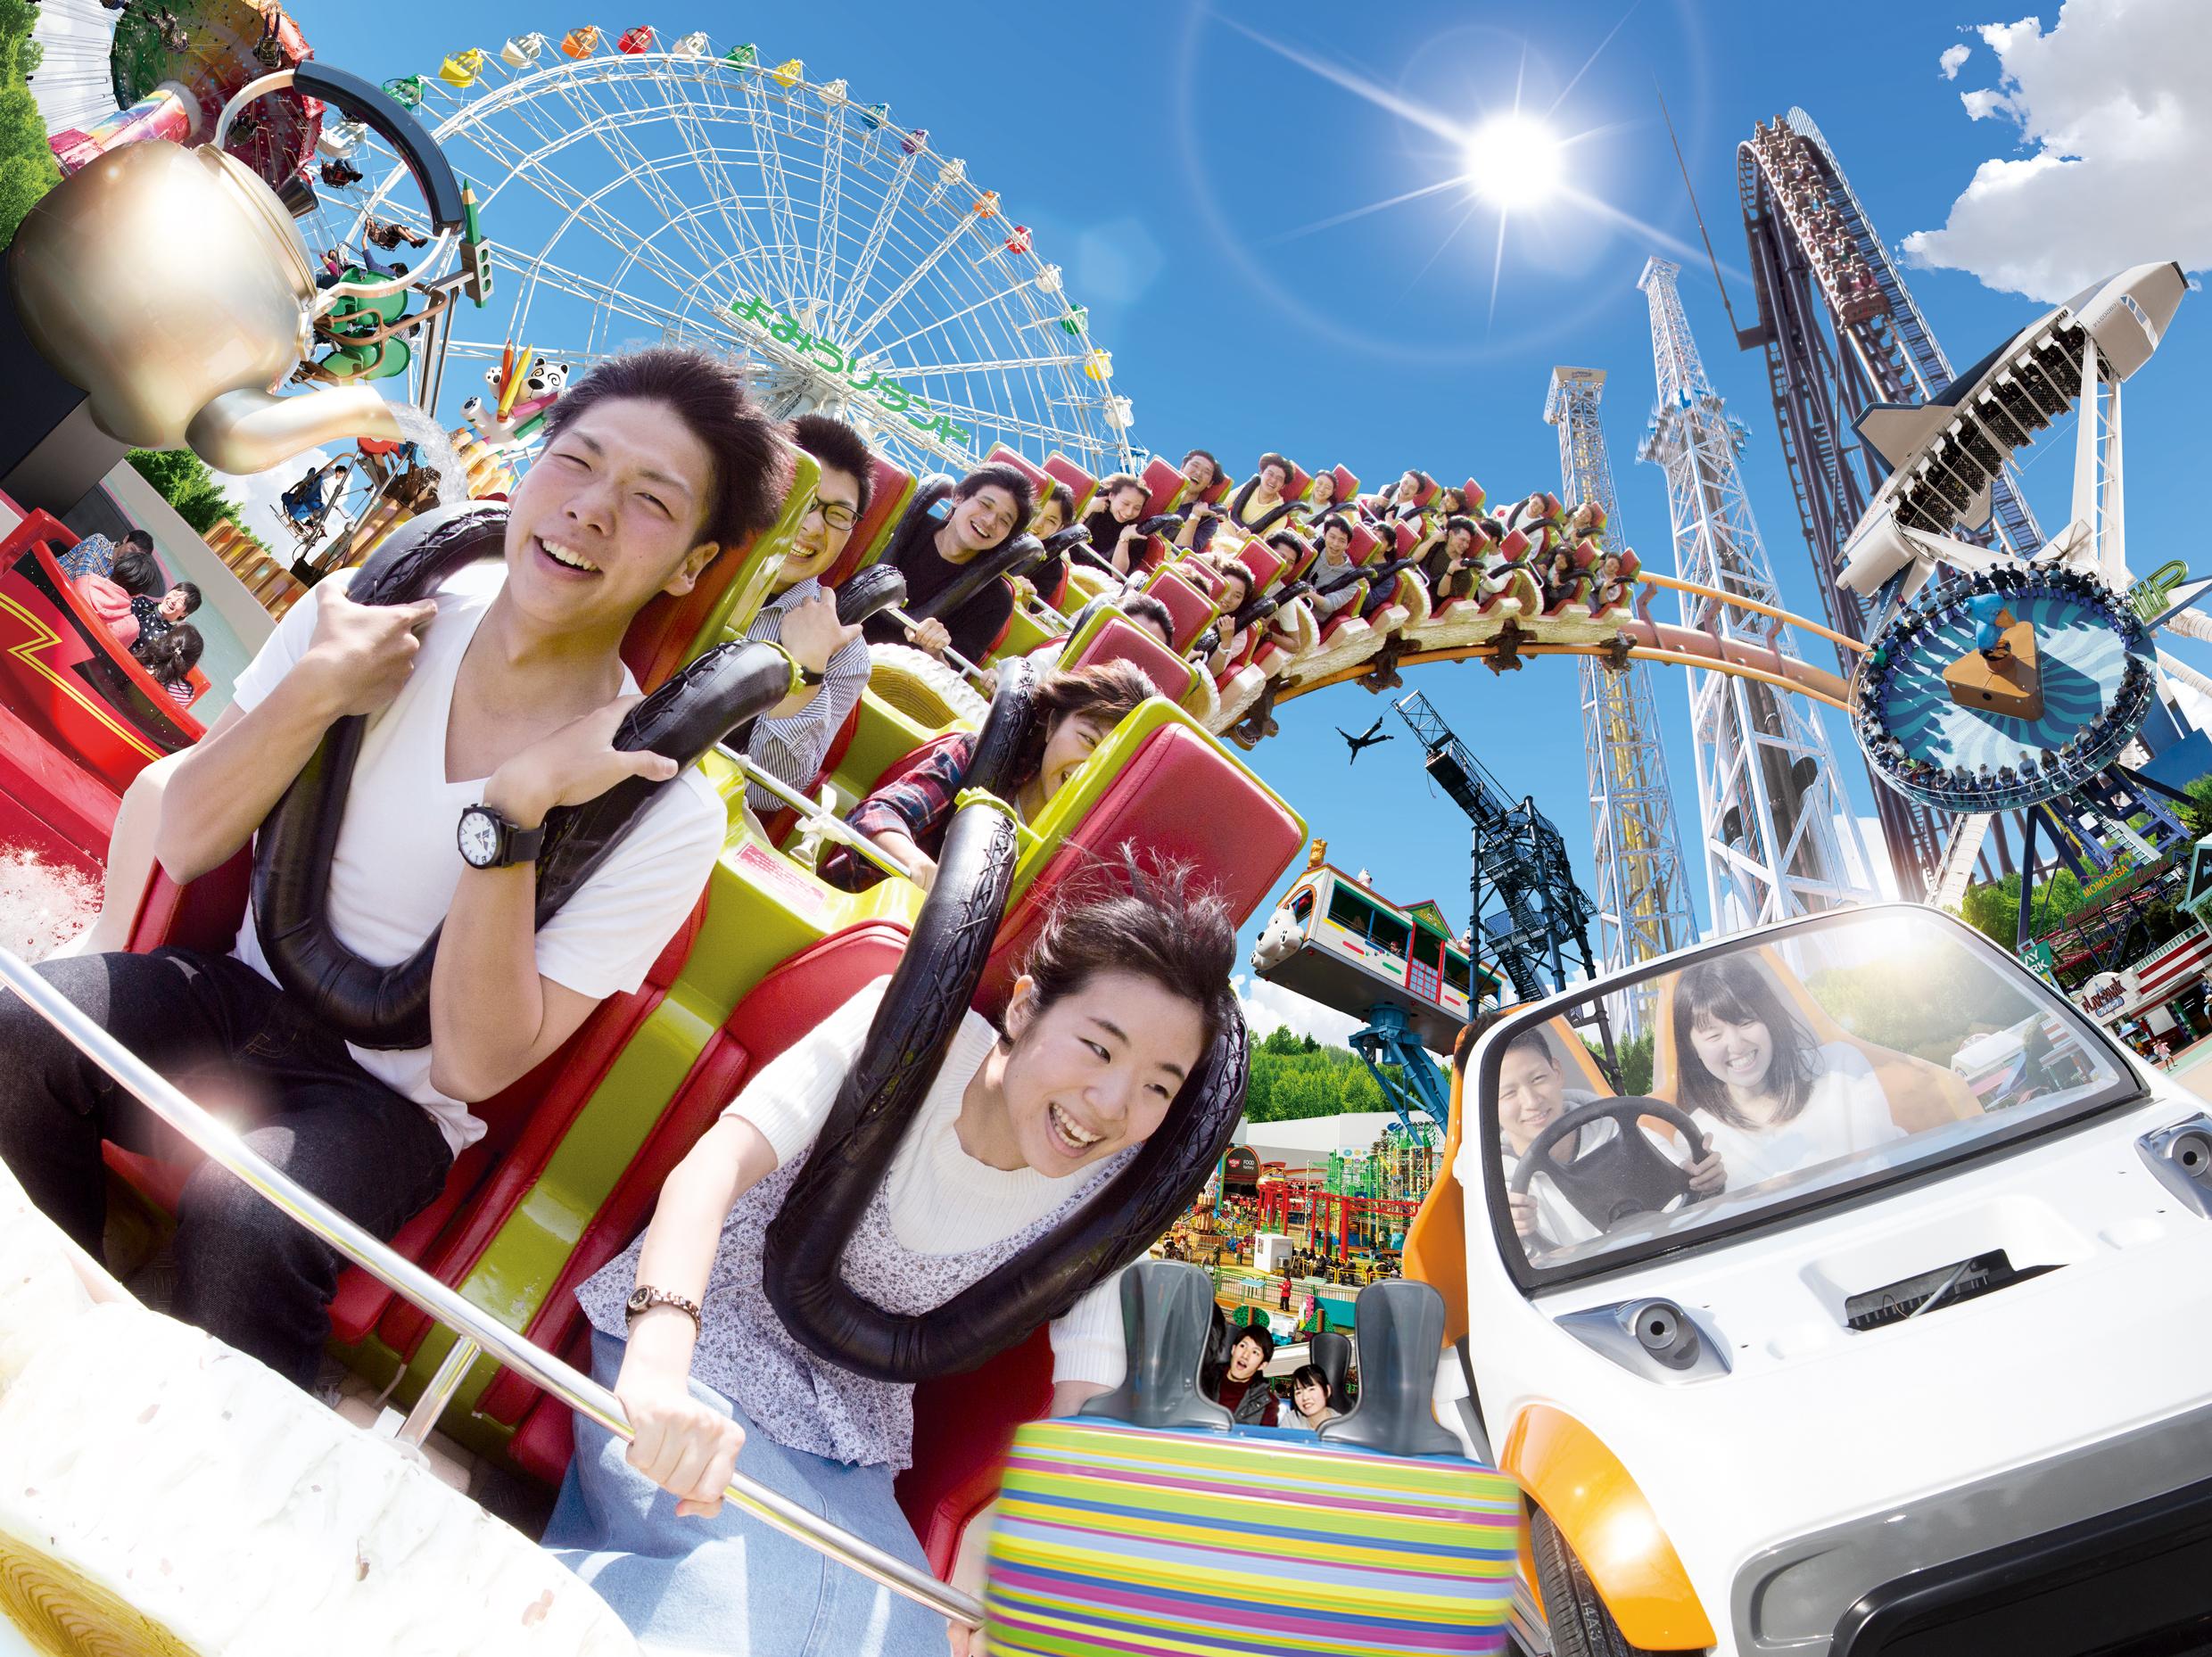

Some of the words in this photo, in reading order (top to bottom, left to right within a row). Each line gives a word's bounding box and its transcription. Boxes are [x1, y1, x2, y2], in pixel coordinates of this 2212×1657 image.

[731, 295, 969, 444] よみうりランド
